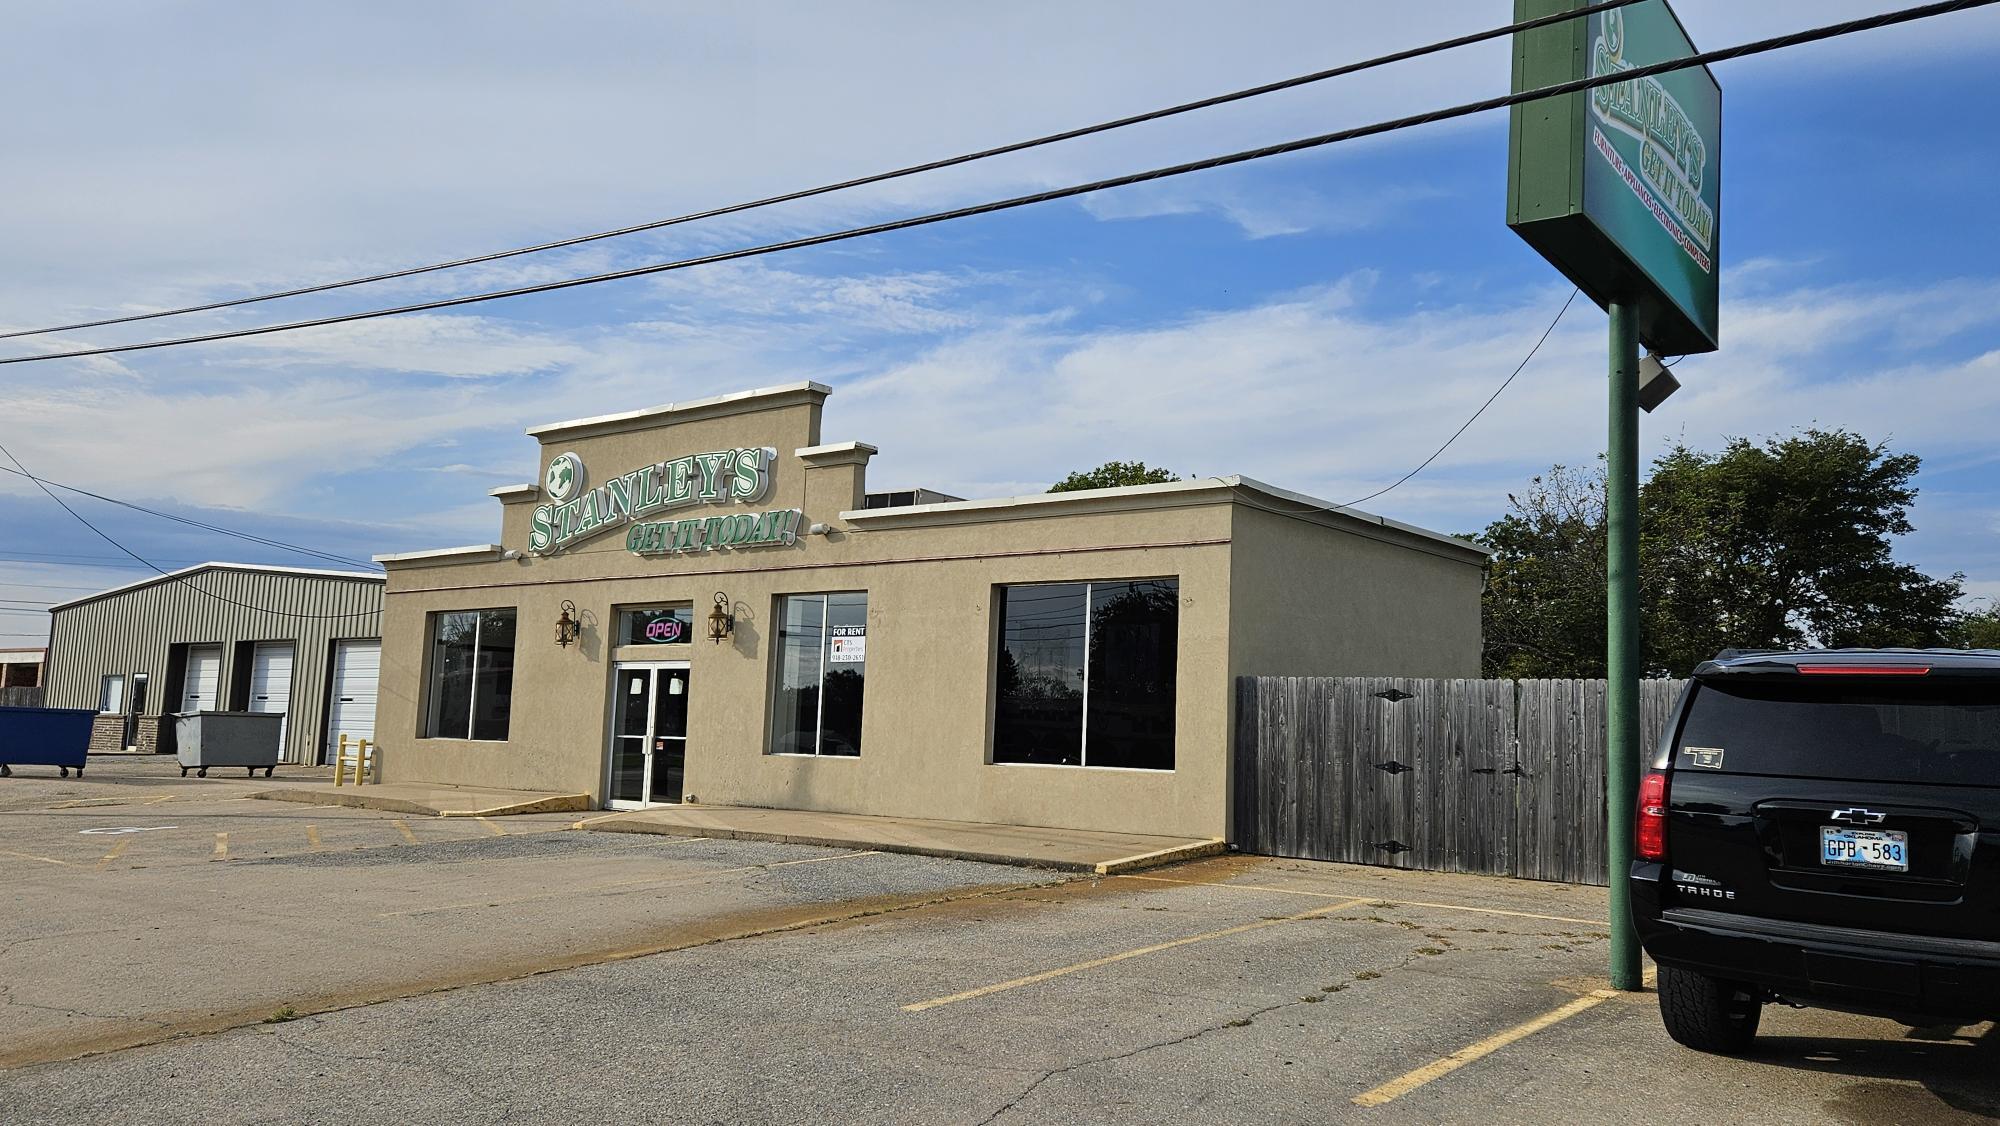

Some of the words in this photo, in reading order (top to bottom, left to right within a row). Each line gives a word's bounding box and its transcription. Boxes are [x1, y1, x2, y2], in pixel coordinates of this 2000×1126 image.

[1596, 44, 1702, 184] STANLEY'S
[1594, 131, 1622, 172] FURNITURE
[1624, 170, 1652, 208] APPLIANCES
[1654, 203, 1683, 242] ELECTRONICS
[1684, 237, 1710, 271] COMPUTERS
[1642, 142, 1664, 184] GET
[1663, 165, 1676, 198] IT
[1675, 183, 1711, 244] TODAY!
[528, 447, 766, 552] STANLEY'S
[626, 520, 674, 553] GET
[674, 517, 702, 550] IT
[702, 509, 797, 550] TODAY!
[646, 622, 682, 637] OPEN
[833, 628, 846, 636] FOR
[847, 627, 865, 636] RENT
[1828, 840, 1856, 858] GPB
[1872, 843, 1902, 861] 583
[1677, 884, 1736, 899] TAHOE
